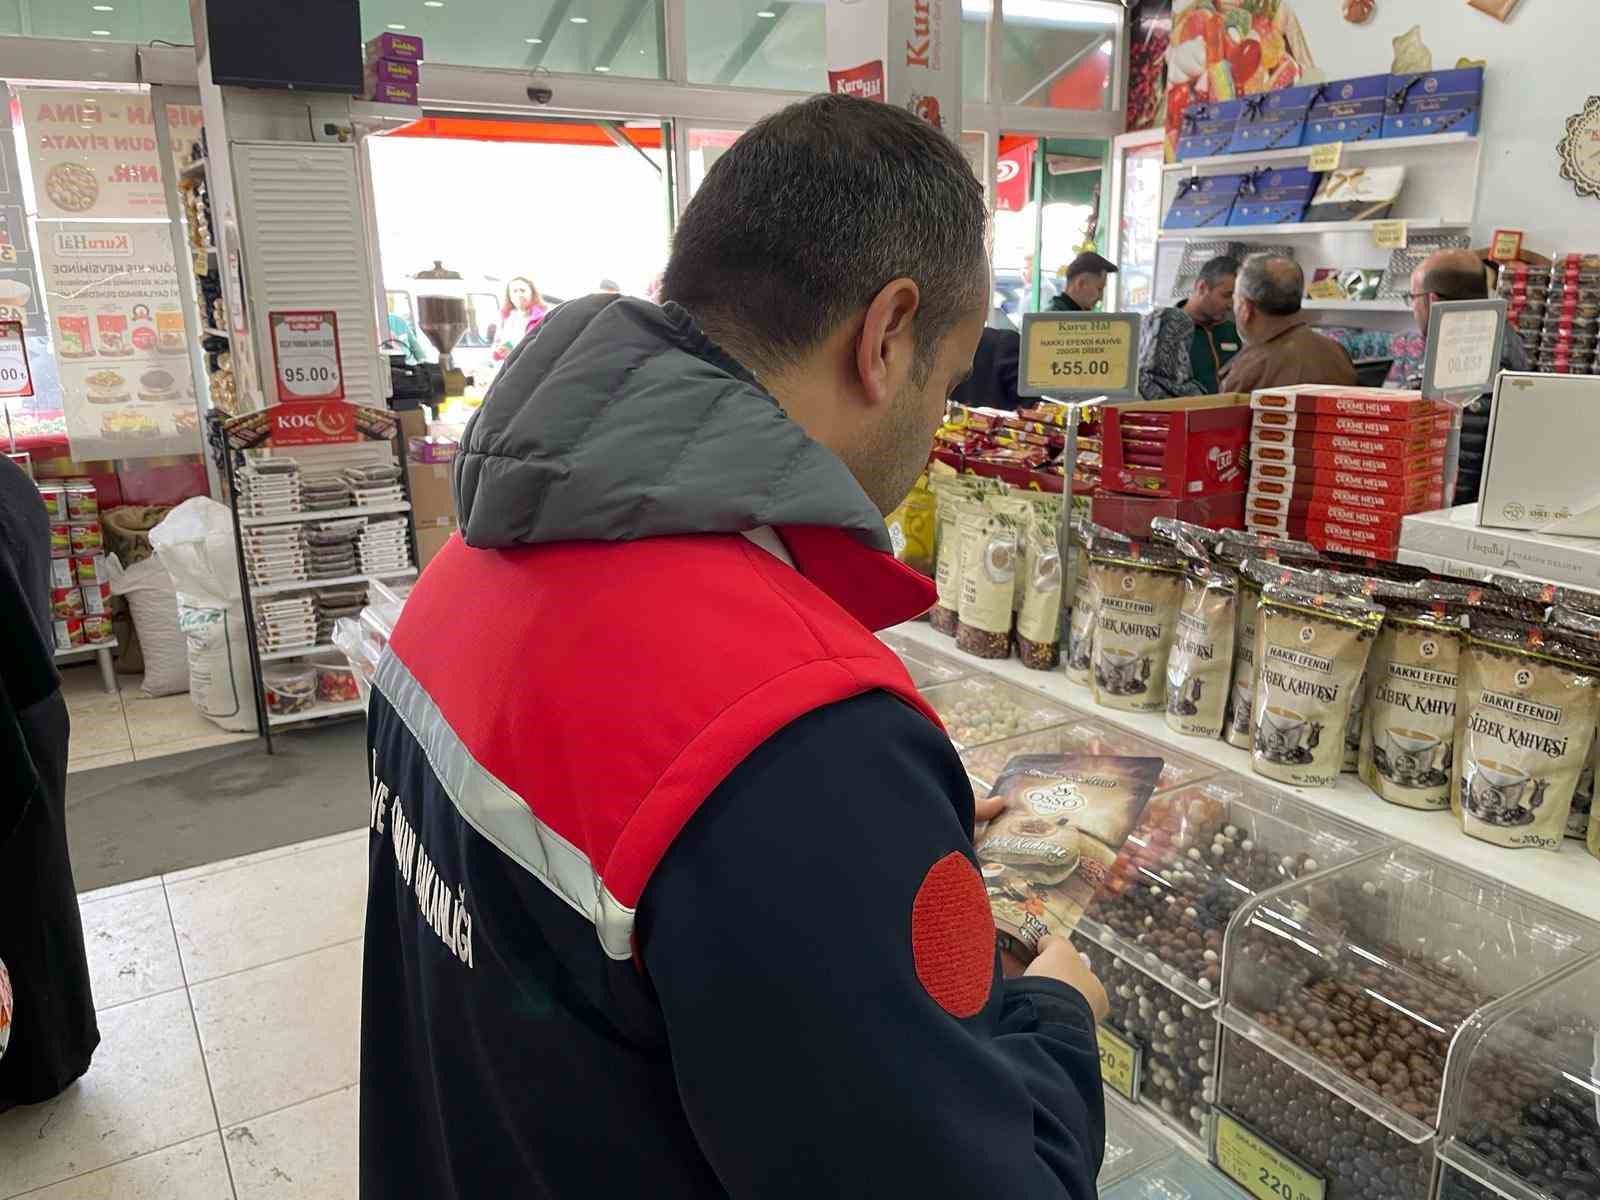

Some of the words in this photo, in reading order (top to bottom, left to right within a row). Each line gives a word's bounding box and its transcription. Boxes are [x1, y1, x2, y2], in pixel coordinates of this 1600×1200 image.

[284, 367, 328, 383] 95.00
[1269, 647, 1298, 664] HAKKI
[1388, 664, 1420, 680] HAKKI
[1422, 671, 1457, 687] EFEND
[1288, 676, 1339, 704] KAHVESİ
[1481, 692, 1514, 711] HAKKI
[1413, 694, 1456, 717] KAHV
[1466, 711, 1510, 745] DİBEK
[1508, 724, 1569, 759] KAHVESİ
